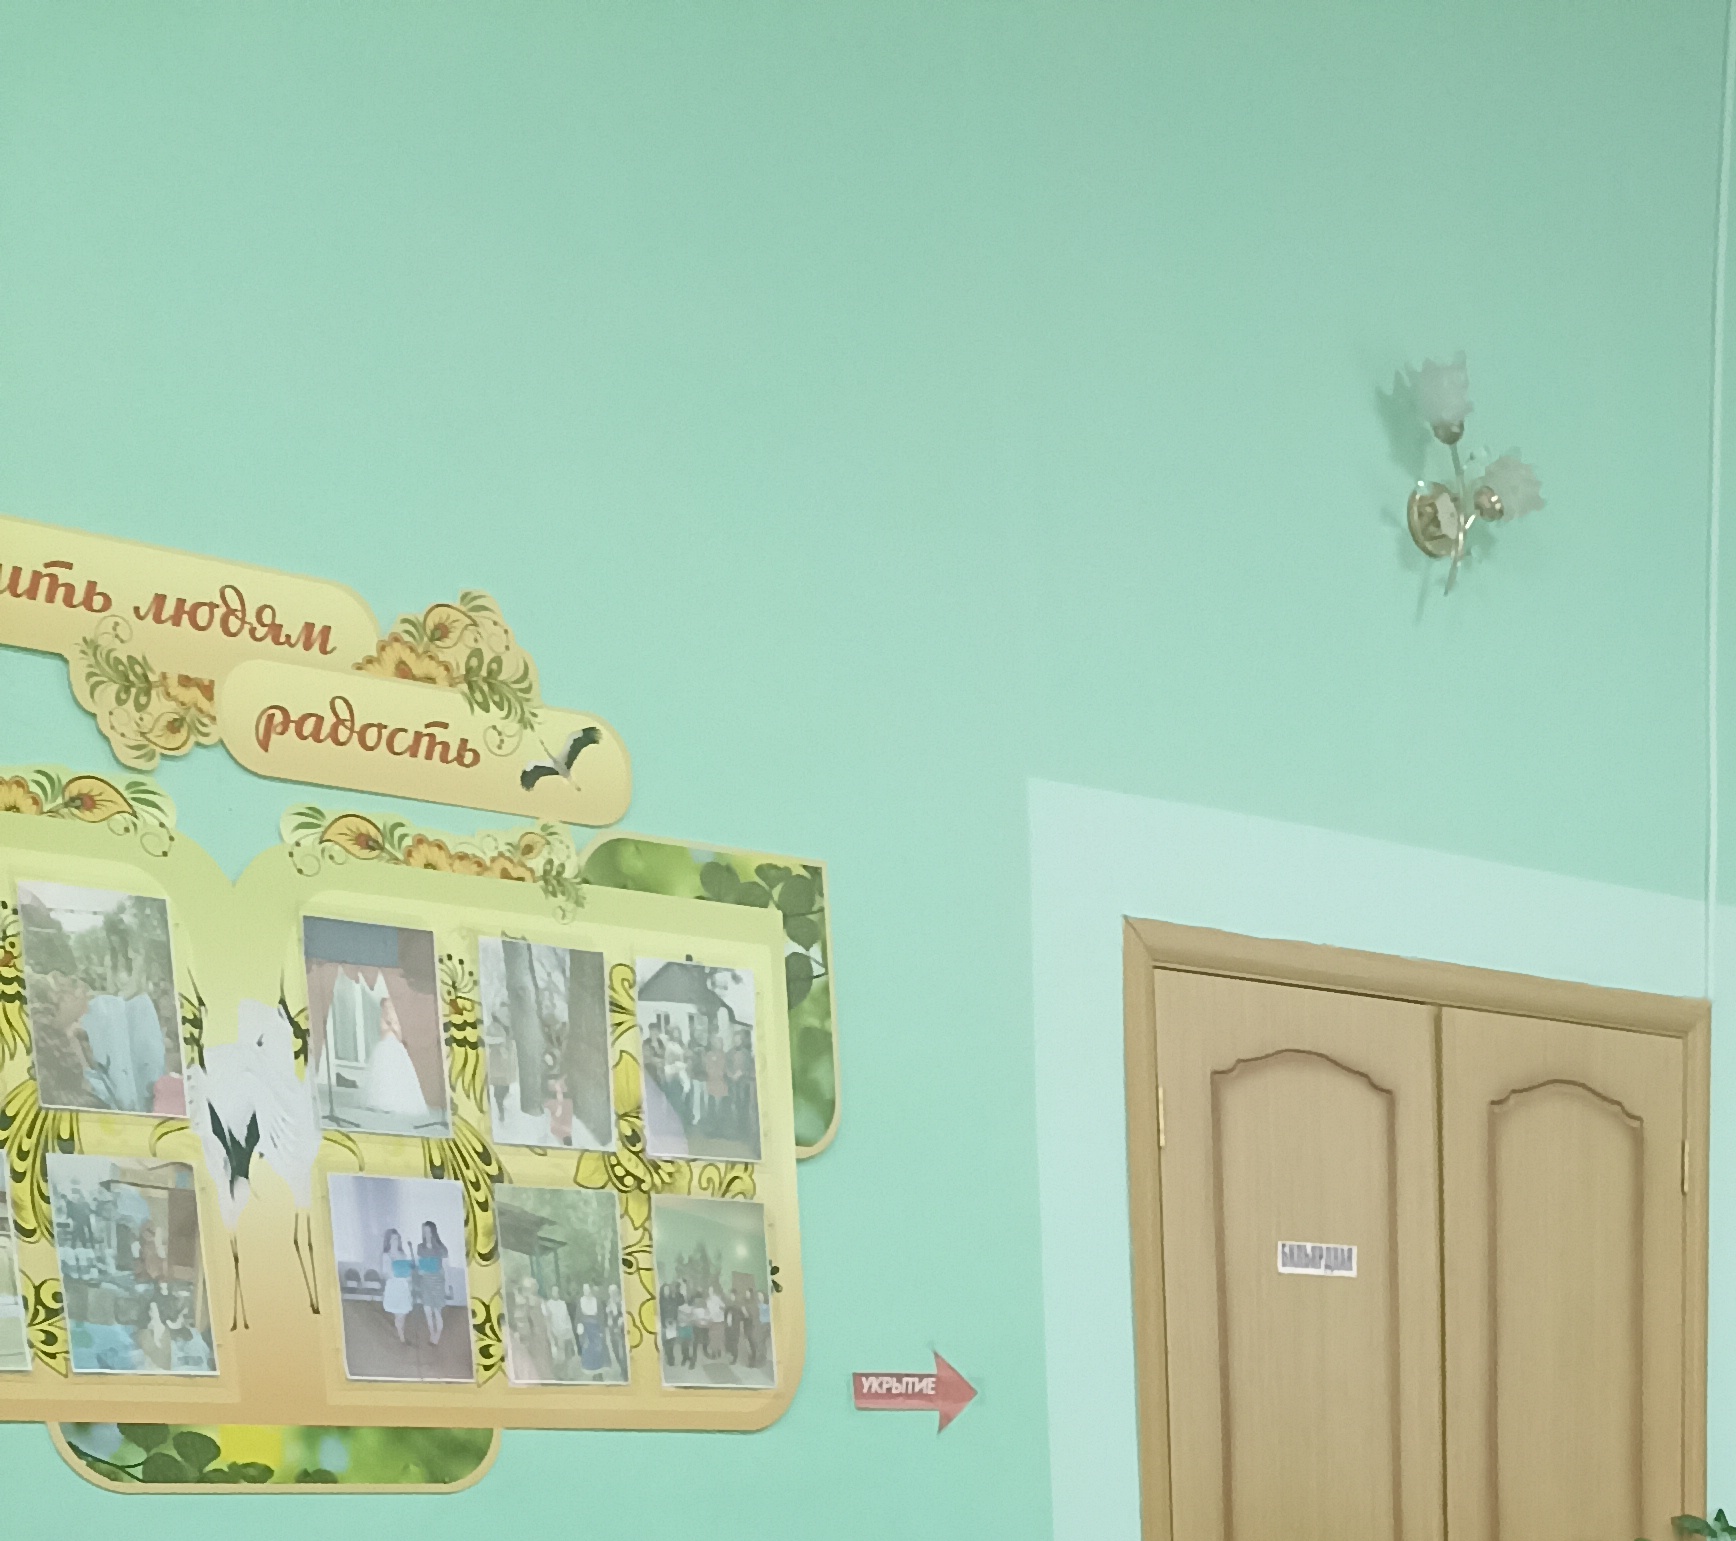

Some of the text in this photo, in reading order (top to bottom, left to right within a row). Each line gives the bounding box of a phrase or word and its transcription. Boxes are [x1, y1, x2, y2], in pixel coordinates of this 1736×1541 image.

[133, 584, 337, 655] людям
[255, 695, 481, 768] радость
[861, 1376, 937, 1395] УКРЫТИЕ
